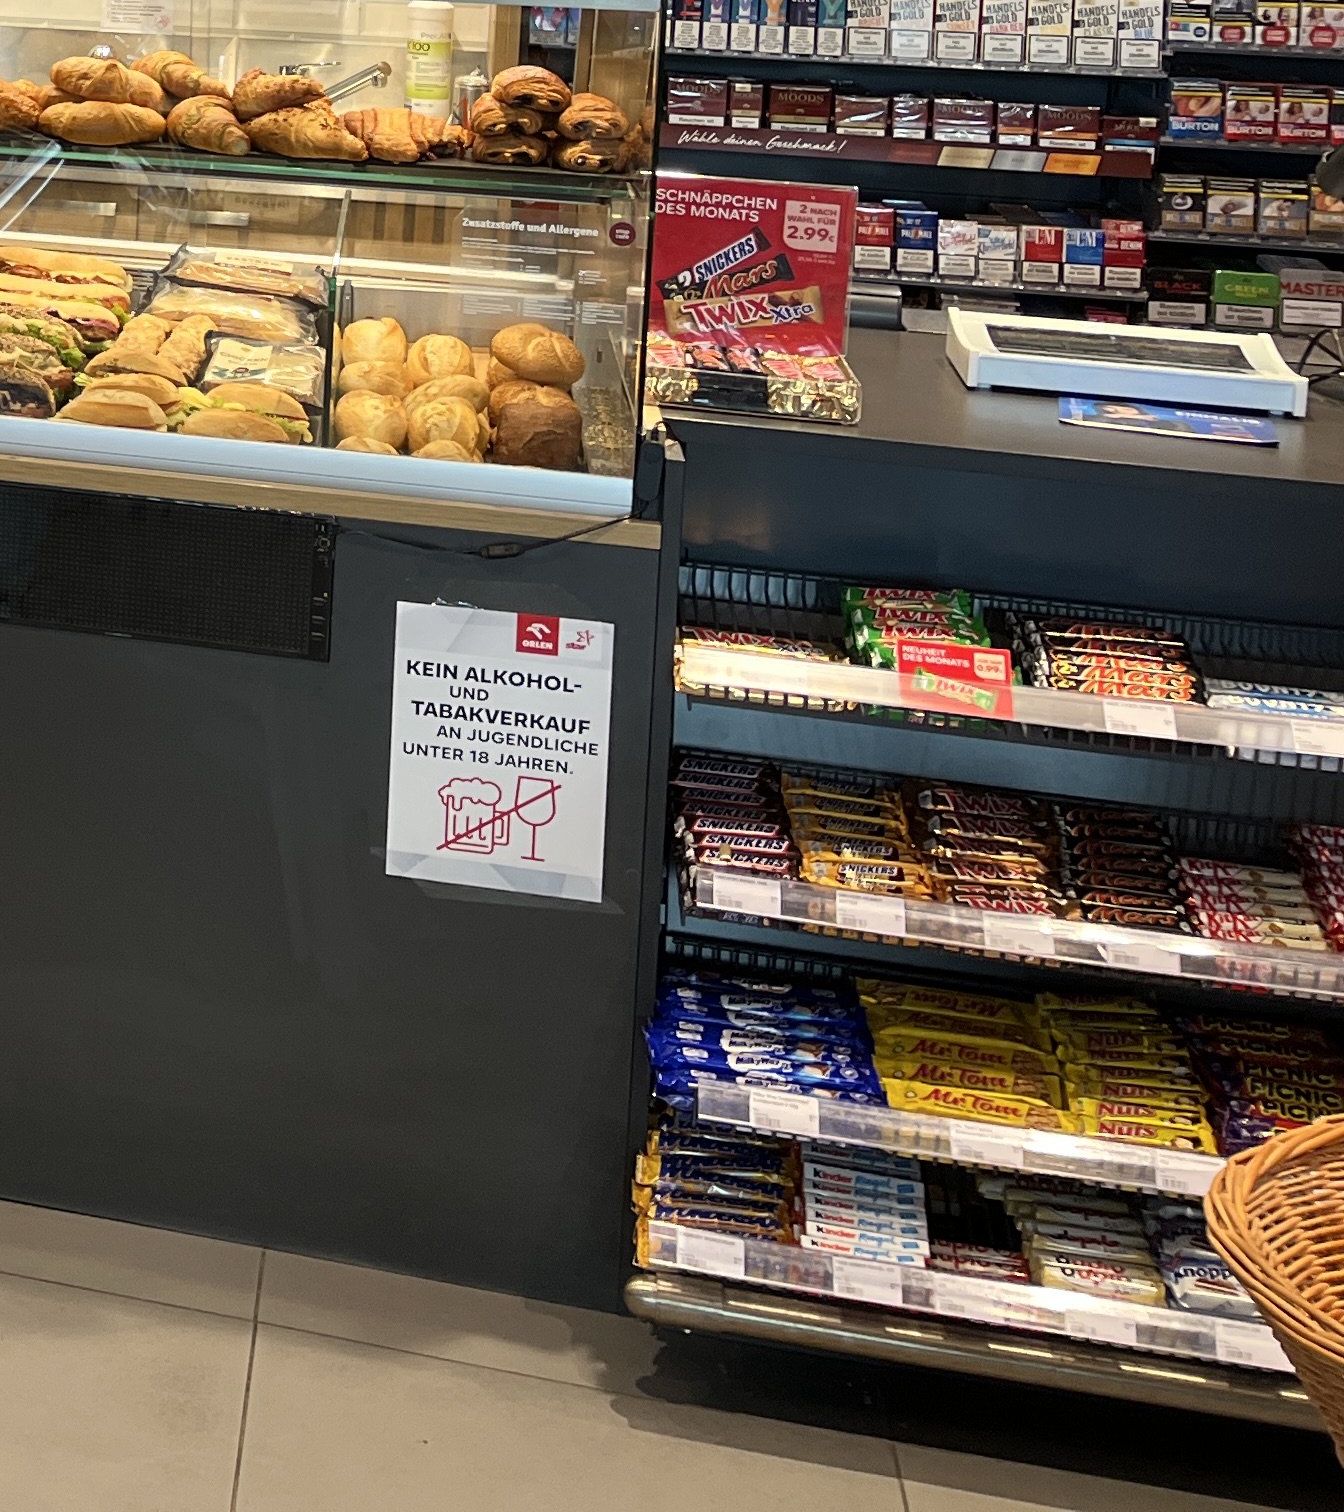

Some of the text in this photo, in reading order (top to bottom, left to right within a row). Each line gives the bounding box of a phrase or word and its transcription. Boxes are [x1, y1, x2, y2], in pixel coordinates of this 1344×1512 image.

[1172, 119, 1219, 132] BURTON
[1226, 124, 1273, 136] BURTON
[655, 187, 778, 211] SCHNÄPPCHEN
[654, 202, 759, 223] DES MONATS
[787, 214, 837, 227] WAHL FÜR
[799, 203, 838, 218] 2 NACH
[462, 217, 599, 238] Zusatzstoffe und Allergene
[696, 236, 755, 283] SNICKERS
[703, 260, 779, 300] Mars
[770, 303, 815, 326] Xtra
[522, 640, 553, 650] ORLEN
[902, 645, 947, 657] NEUHEIT
[902, 653, 970, 668] DES MONATS
[406, 659, 582, 694] KEIN ALKOHOL-
[449, 686, 489, 702] UND
[411, 700, 591, 735] TABAKVERKAUF
[436, 725, 599, 756] AN JUGENDLICHE
[403, 742, 574, 775] UNTER 18 JAHREN.
[697, 818, 777, 834] SNICKERS
[952, 1067, 1011, 1089] Tom
[1243, 1061, 1332, 1086] PICNIC
[1249, 1077, 1341, 1109] PICNIC
[967, 1092, 1023, 1118] Tom
[813, 1169, 853, 1184] kinder
